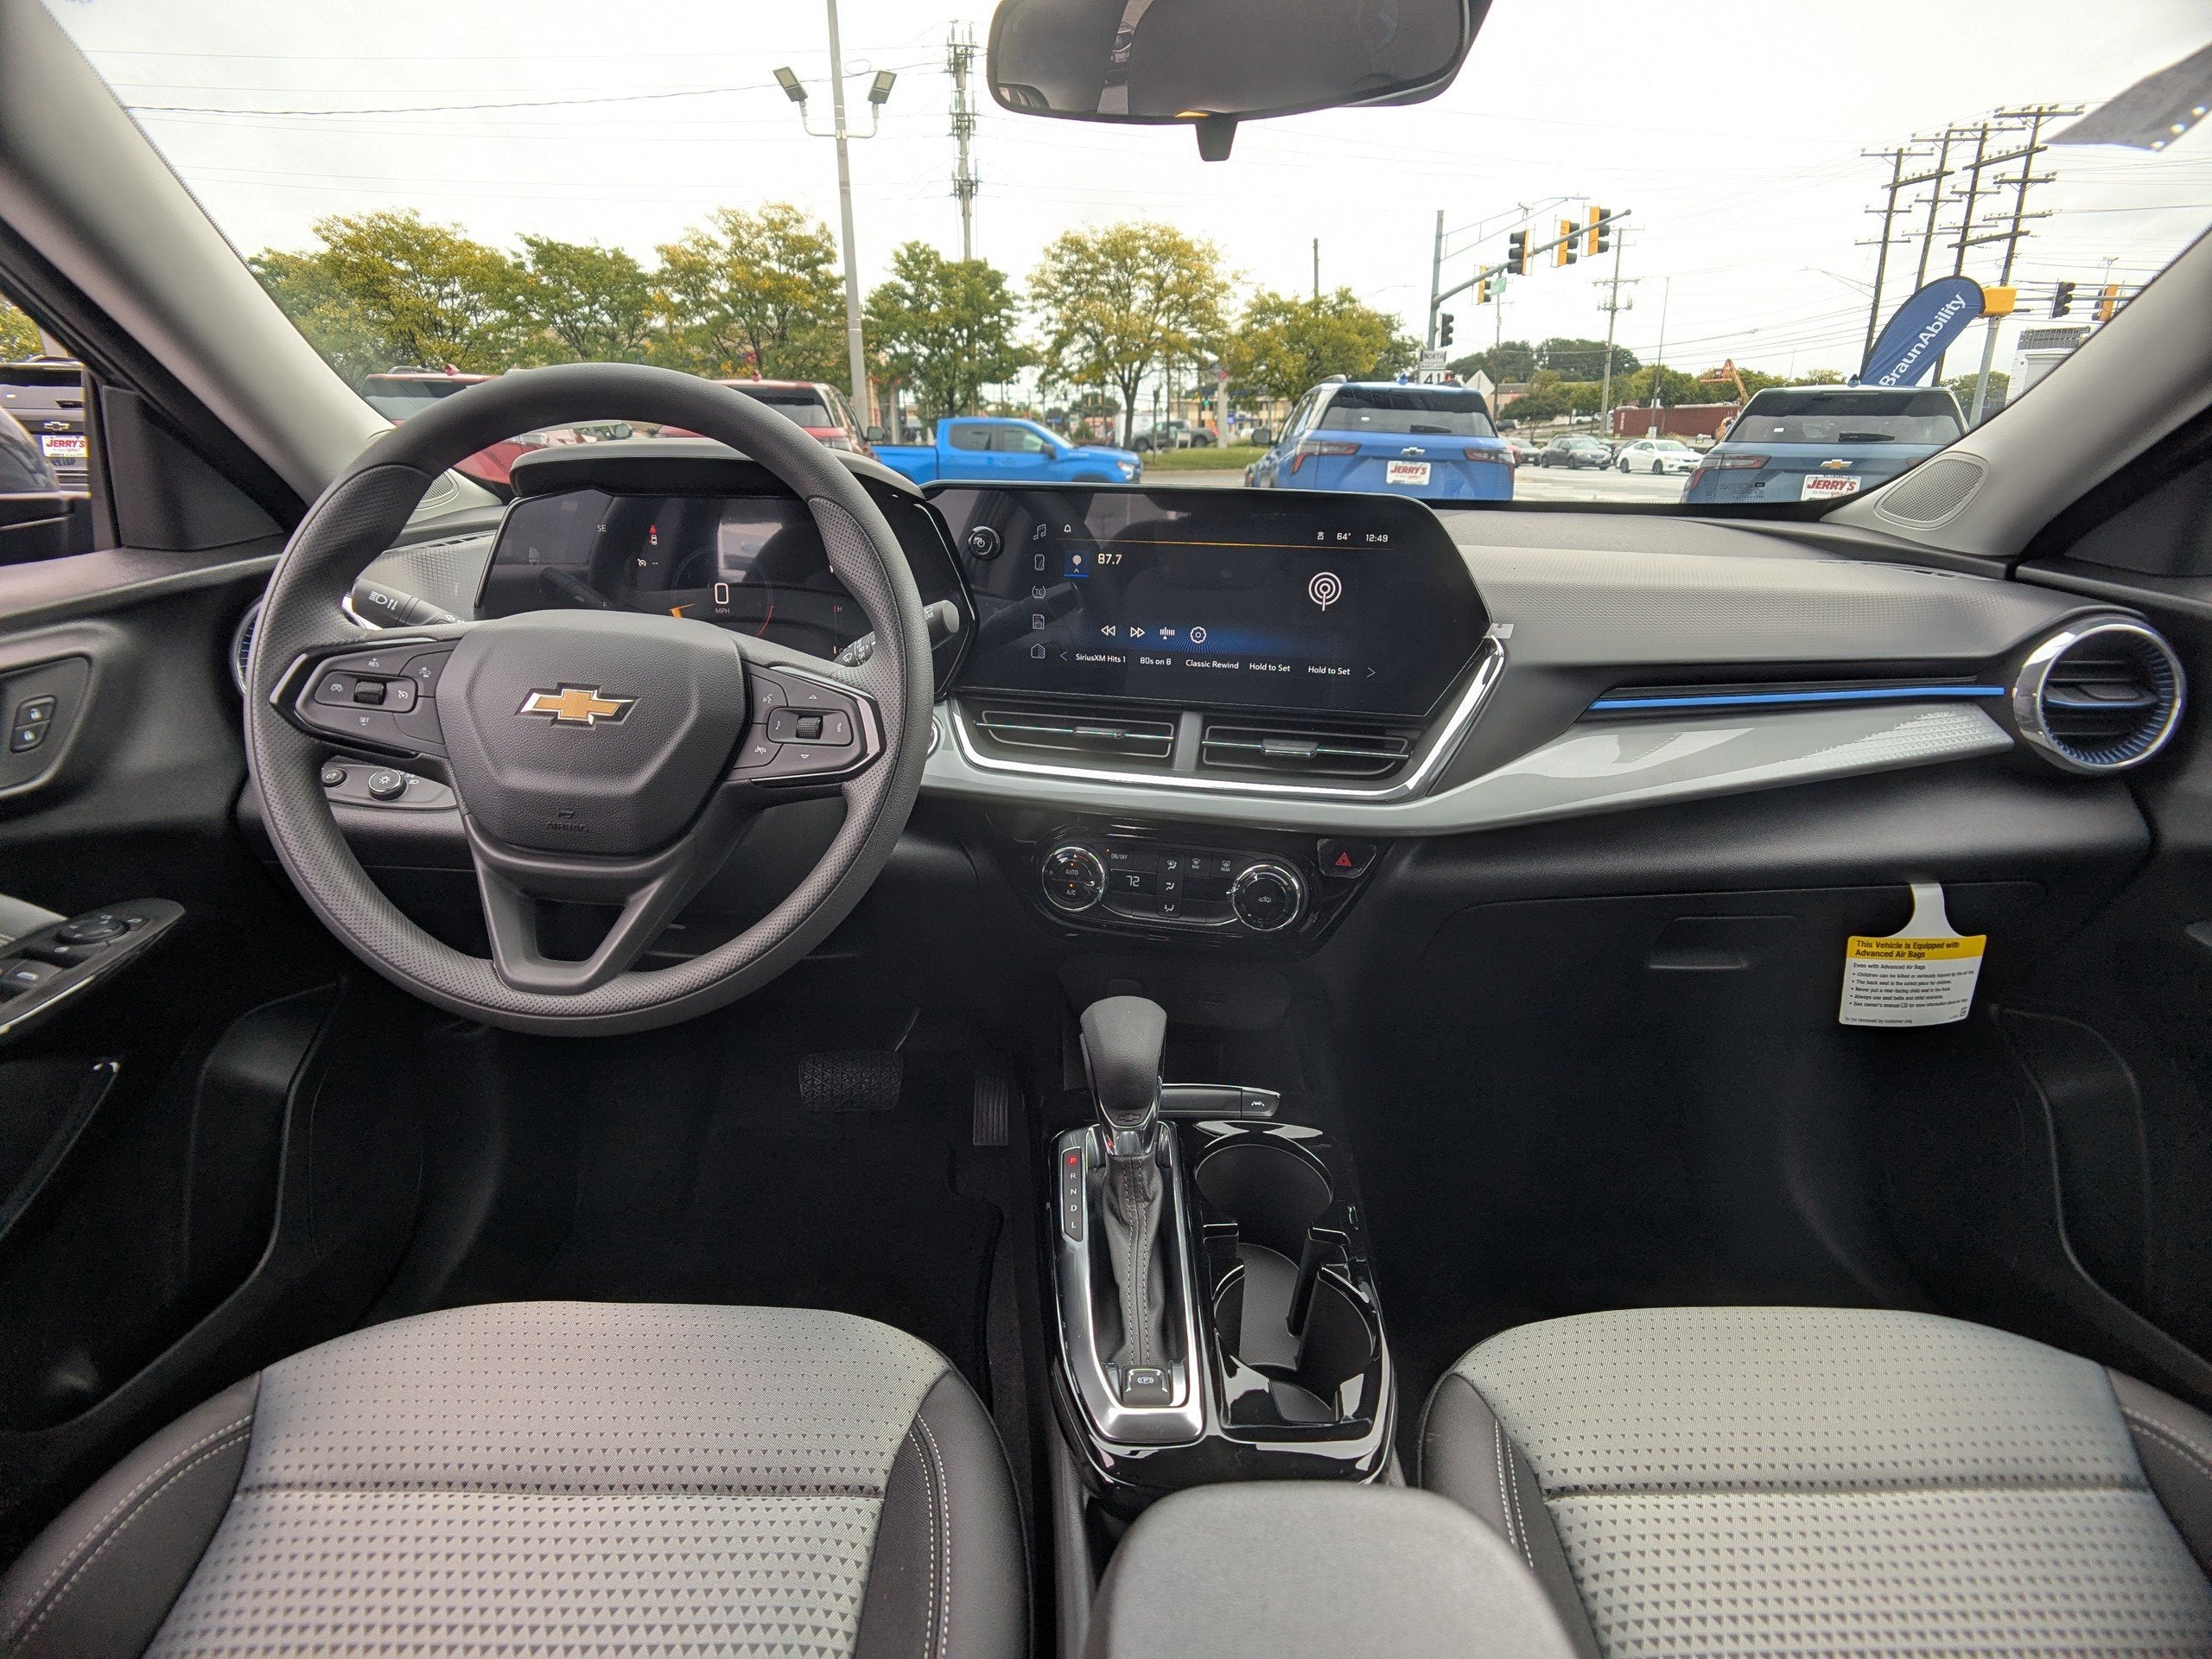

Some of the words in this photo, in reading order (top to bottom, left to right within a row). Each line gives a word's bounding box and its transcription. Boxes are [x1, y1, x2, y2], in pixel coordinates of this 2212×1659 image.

[1878, 293, 1966, 386] BraunAbility
[1423, 372, 1440, 385] 41
[47, 439, 86, 448] JERRY'S
[1390, 466, 1427, 475] JERRY'S
[1807, 480, 1857, 491] JERRY'S
[1365, 534, 1389, 543] 12:49
[1097, 553, 1122, 565] 87.7
[715, 582, 729, 604] 0
[1075, 653, 1106, 662] SiriusXM
[1185, 659, 1211, 668] Classic
[1212, 661, 1239, 670] Rewind
[1249, 663, 1267, 671] Hold
[1126, 875, 1140, 887] 72
[1857, 940, 1873, 949] This
[1876, 941, 1904, 950] Vehicle
[1912, 942, 1945, 951] Equipped
[1854, 949, 1894, 957] Advanced
